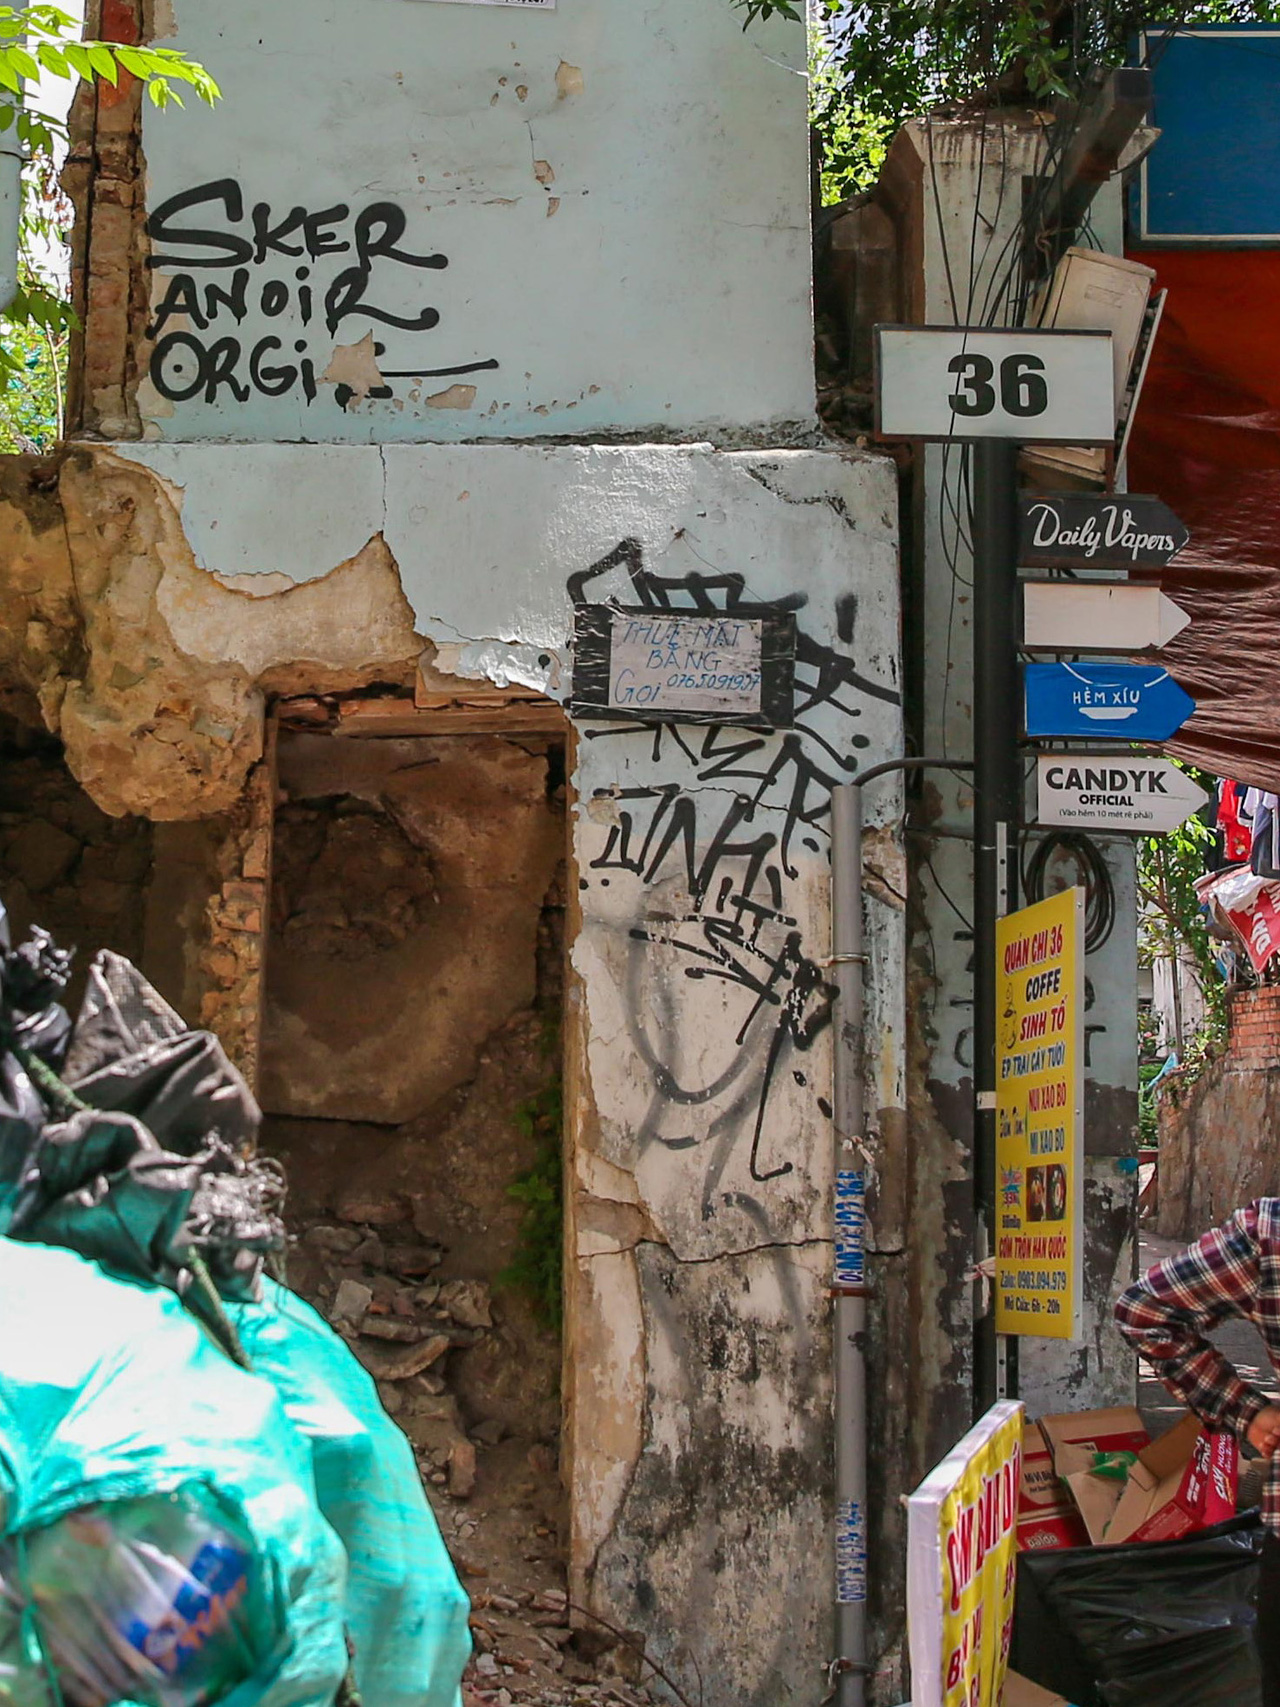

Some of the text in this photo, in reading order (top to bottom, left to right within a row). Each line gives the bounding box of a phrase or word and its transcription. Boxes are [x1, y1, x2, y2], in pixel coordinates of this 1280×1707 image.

[148, 178, 448, 272] SKER
[947, 353, 1048, 417] 36
[1027, 503, 1175, 561] Daily Vapers
[1112, 686, 1140, 705] XÍU
[1045, 767, 1168, 794] CANDYK
[1079, 794, 1134, 807] OFFICIAL
[1097, 809, 1107, 817] 10
[1050, 924, 1063, 957] 36
[1026, 968, 1061, 1002] COFFE
[1020, 994, 1067, 1041] SINH TỐ
